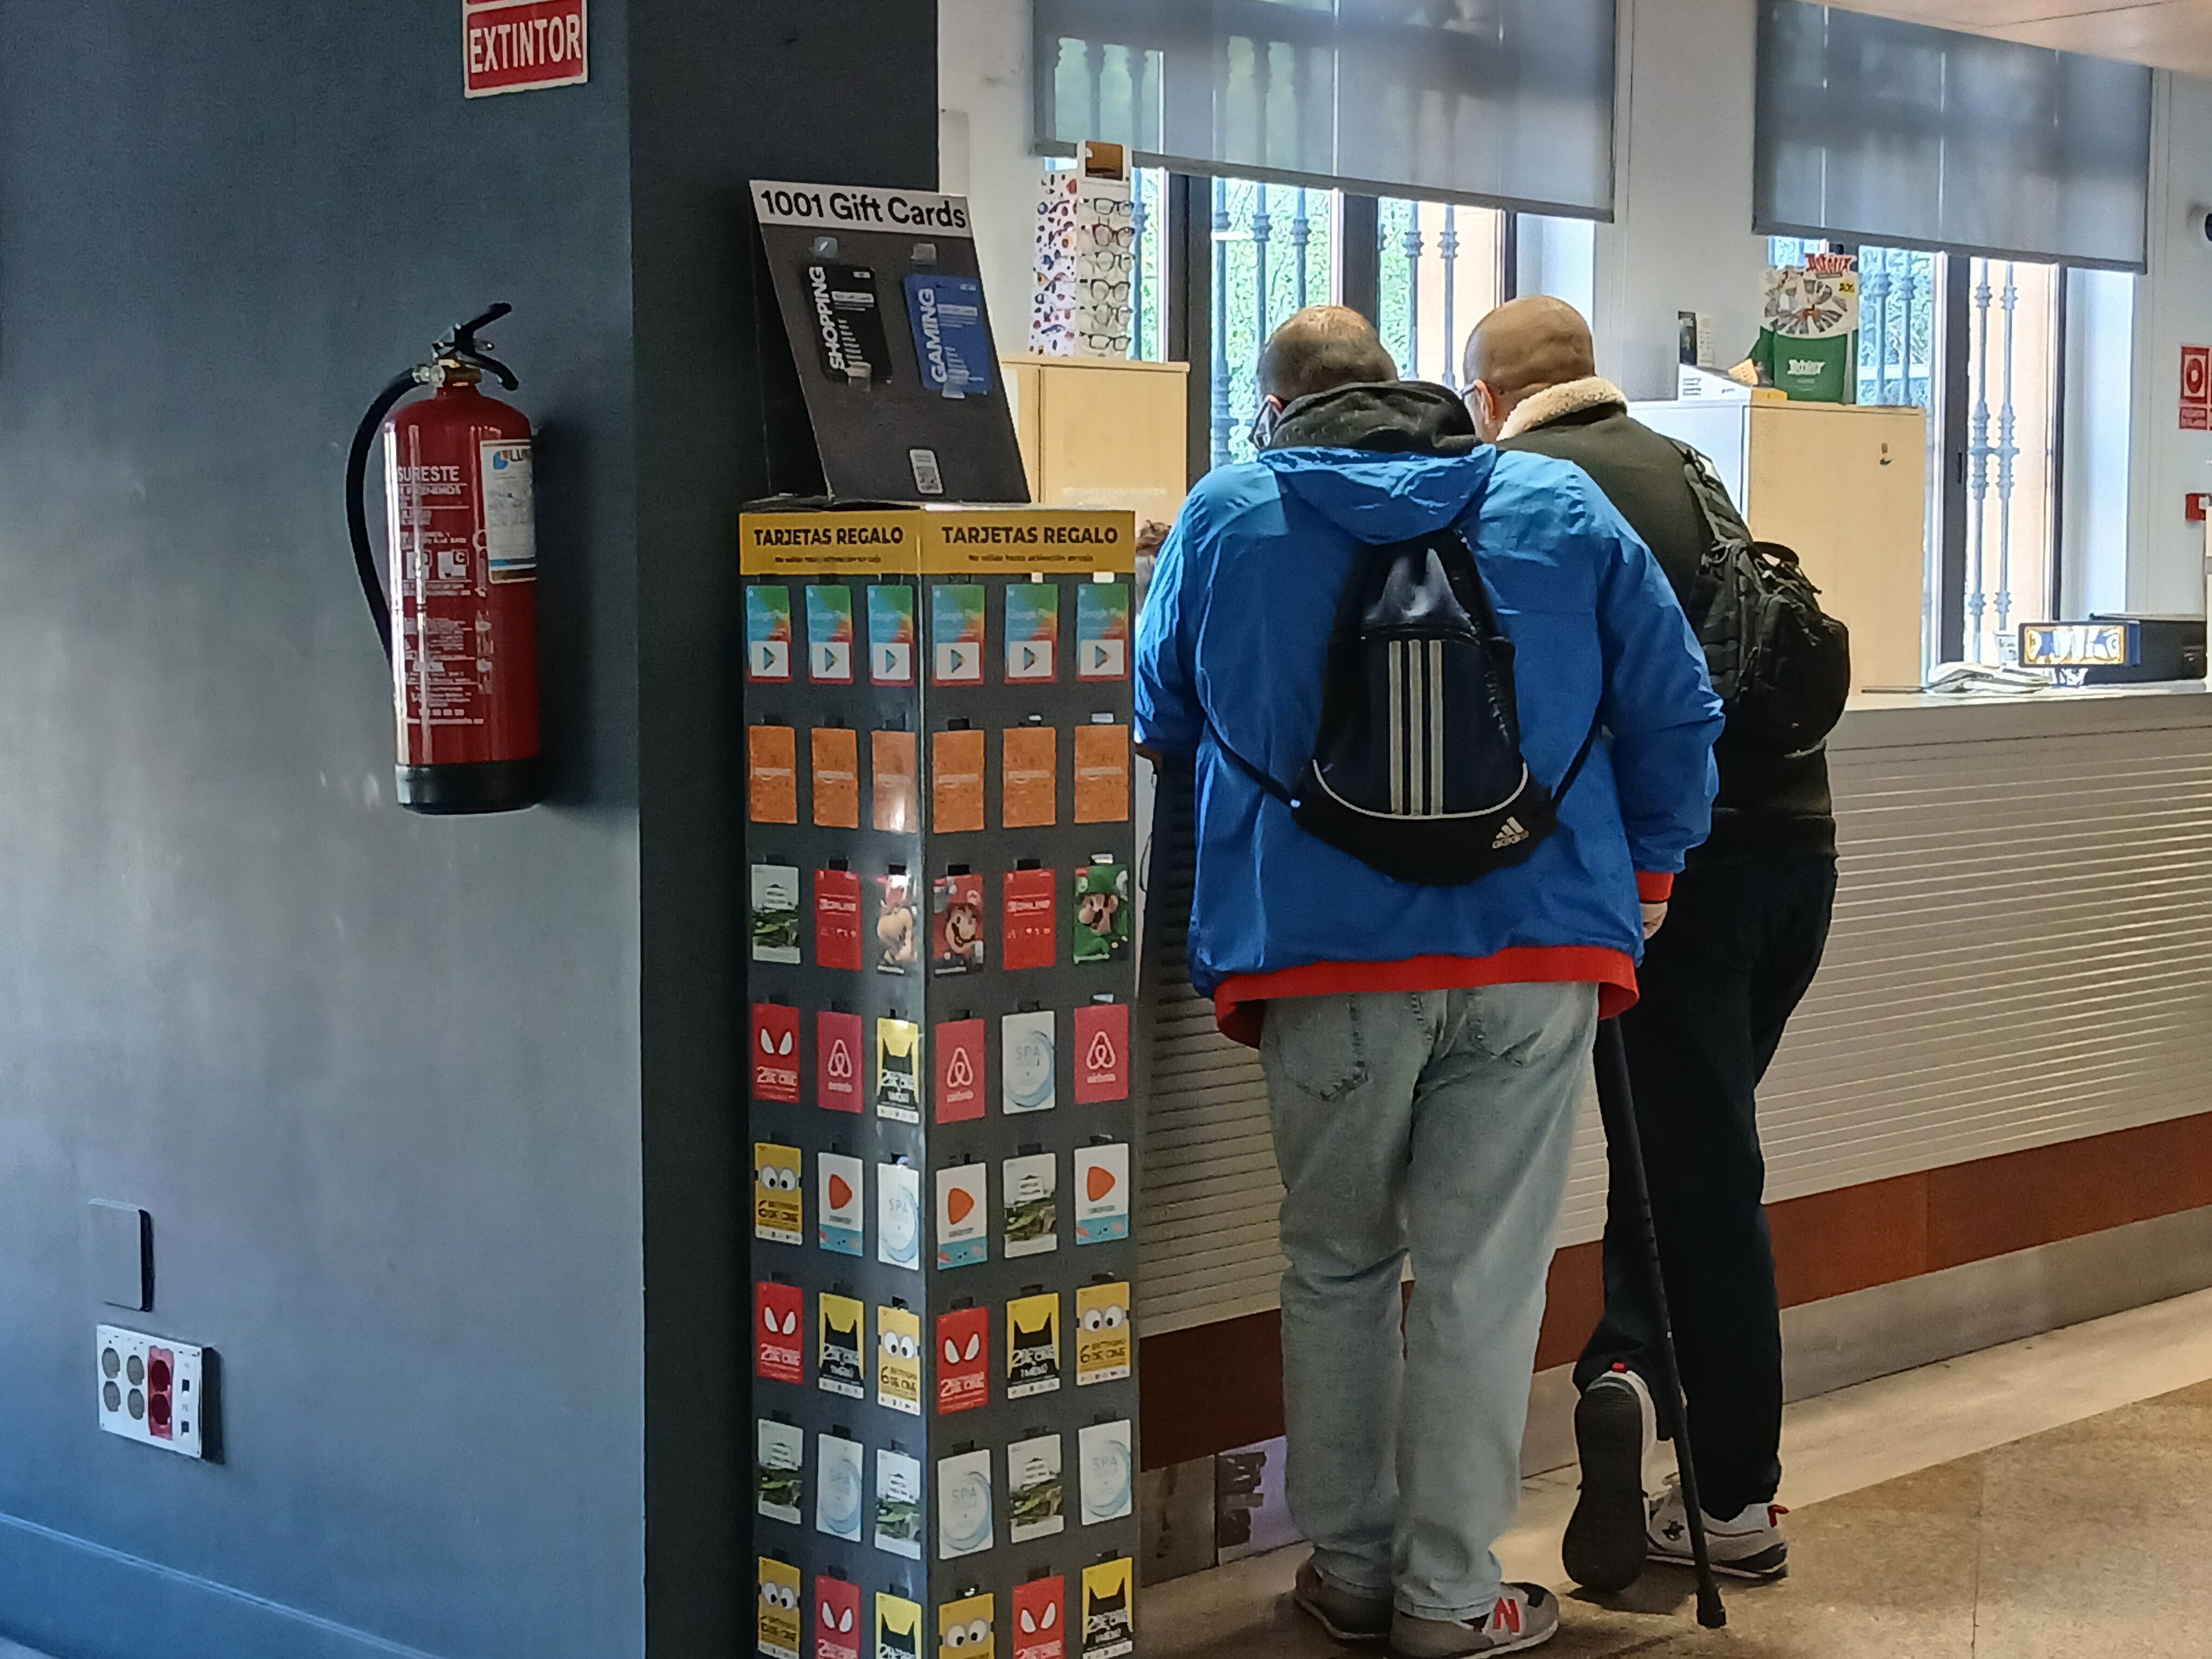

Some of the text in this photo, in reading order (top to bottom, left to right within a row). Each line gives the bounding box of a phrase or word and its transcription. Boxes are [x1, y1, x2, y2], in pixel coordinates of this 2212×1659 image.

[470, 14, 581, 73] EXTINTOR
[761, 190, 966, 228] 1001 Gift Cards
[809, 267, 845, 370] SHOPPING
[918, 288, 947, 383] GAMING
[397, 466, 460, 482] SURESTE
[754, 527, 903, 545] TARJETAS REGALO
[942, 526, 1118, 544] TARJETAS REGALO
[1015, 1046, 1040, 1060] SPA
[1092, 1456, 1118, 1471] SPA
[953, 1487, 977, 1503] SPA
